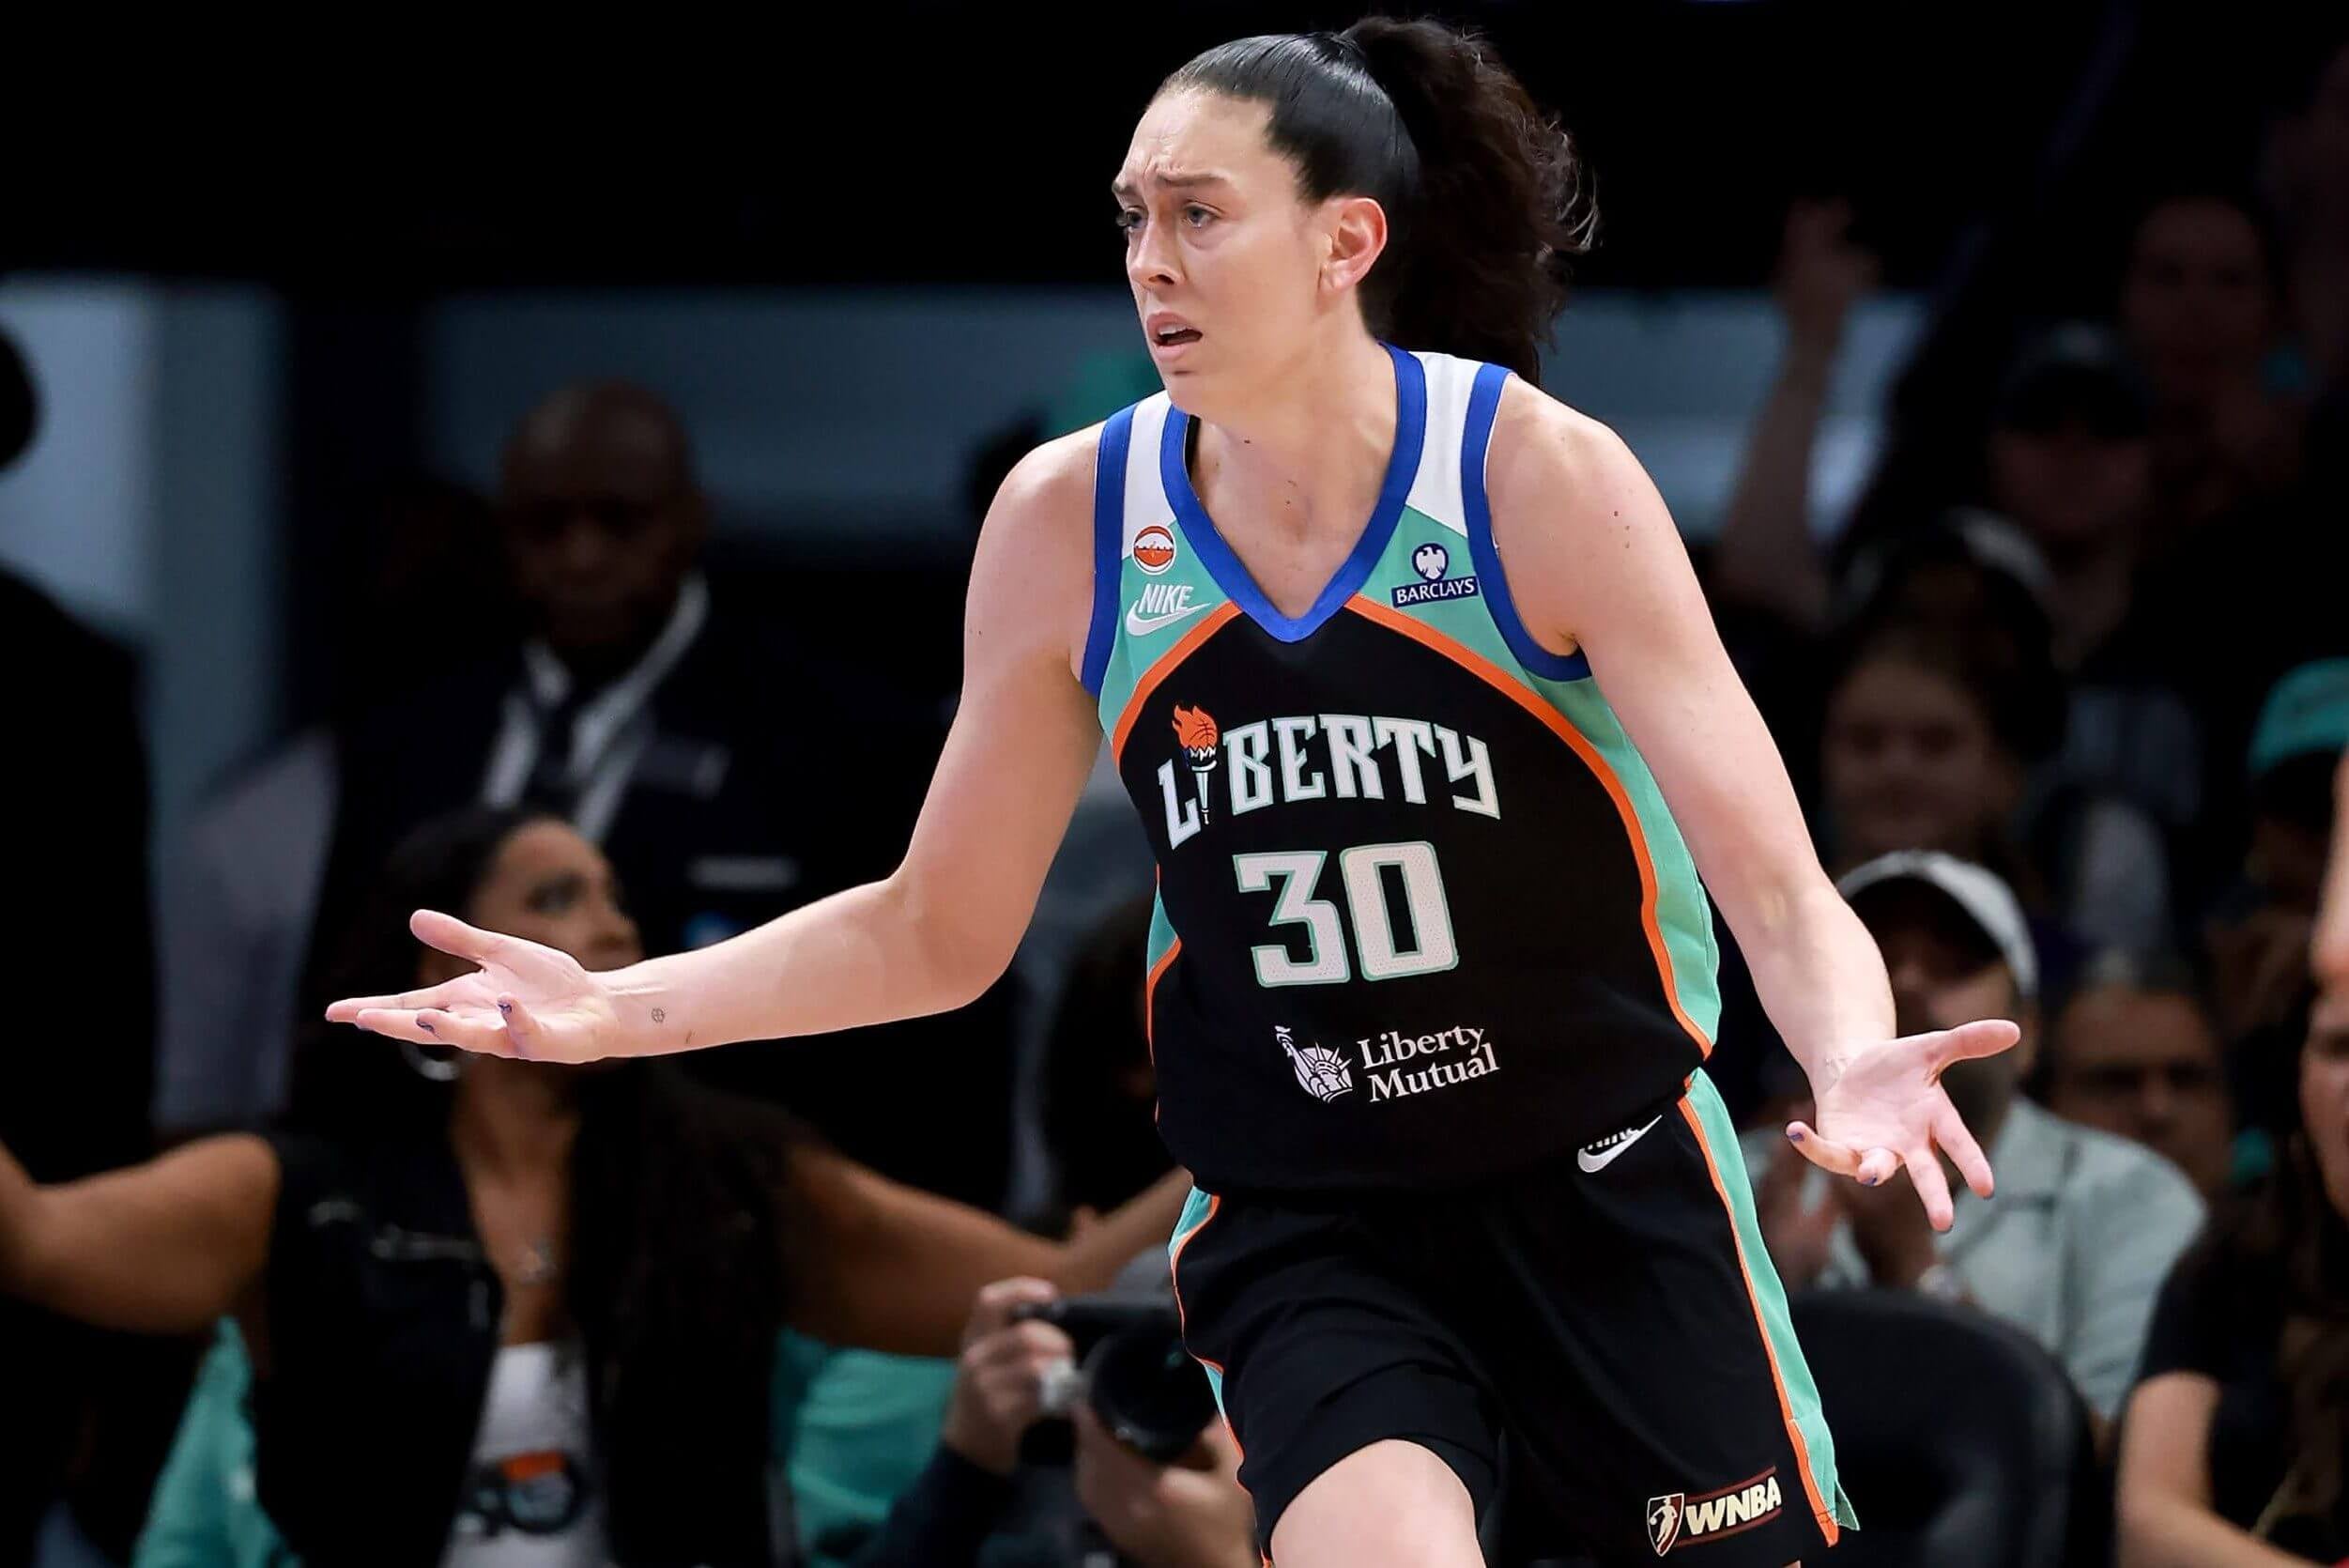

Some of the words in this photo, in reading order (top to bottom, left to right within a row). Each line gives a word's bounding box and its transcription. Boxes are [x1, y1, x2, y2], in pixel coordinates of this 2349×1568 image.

[1137, 583, 1194, 615] NIKE
[1396, 577, 1475, 604] BARCLAYS
[1232, 840, 1460, 989] 30
[1357, 1025, 1484, 1069] Liberty
[1367, 1042, 1500, 1103] Mutual
[1685, 1475, 1783, 1536] WNBA
